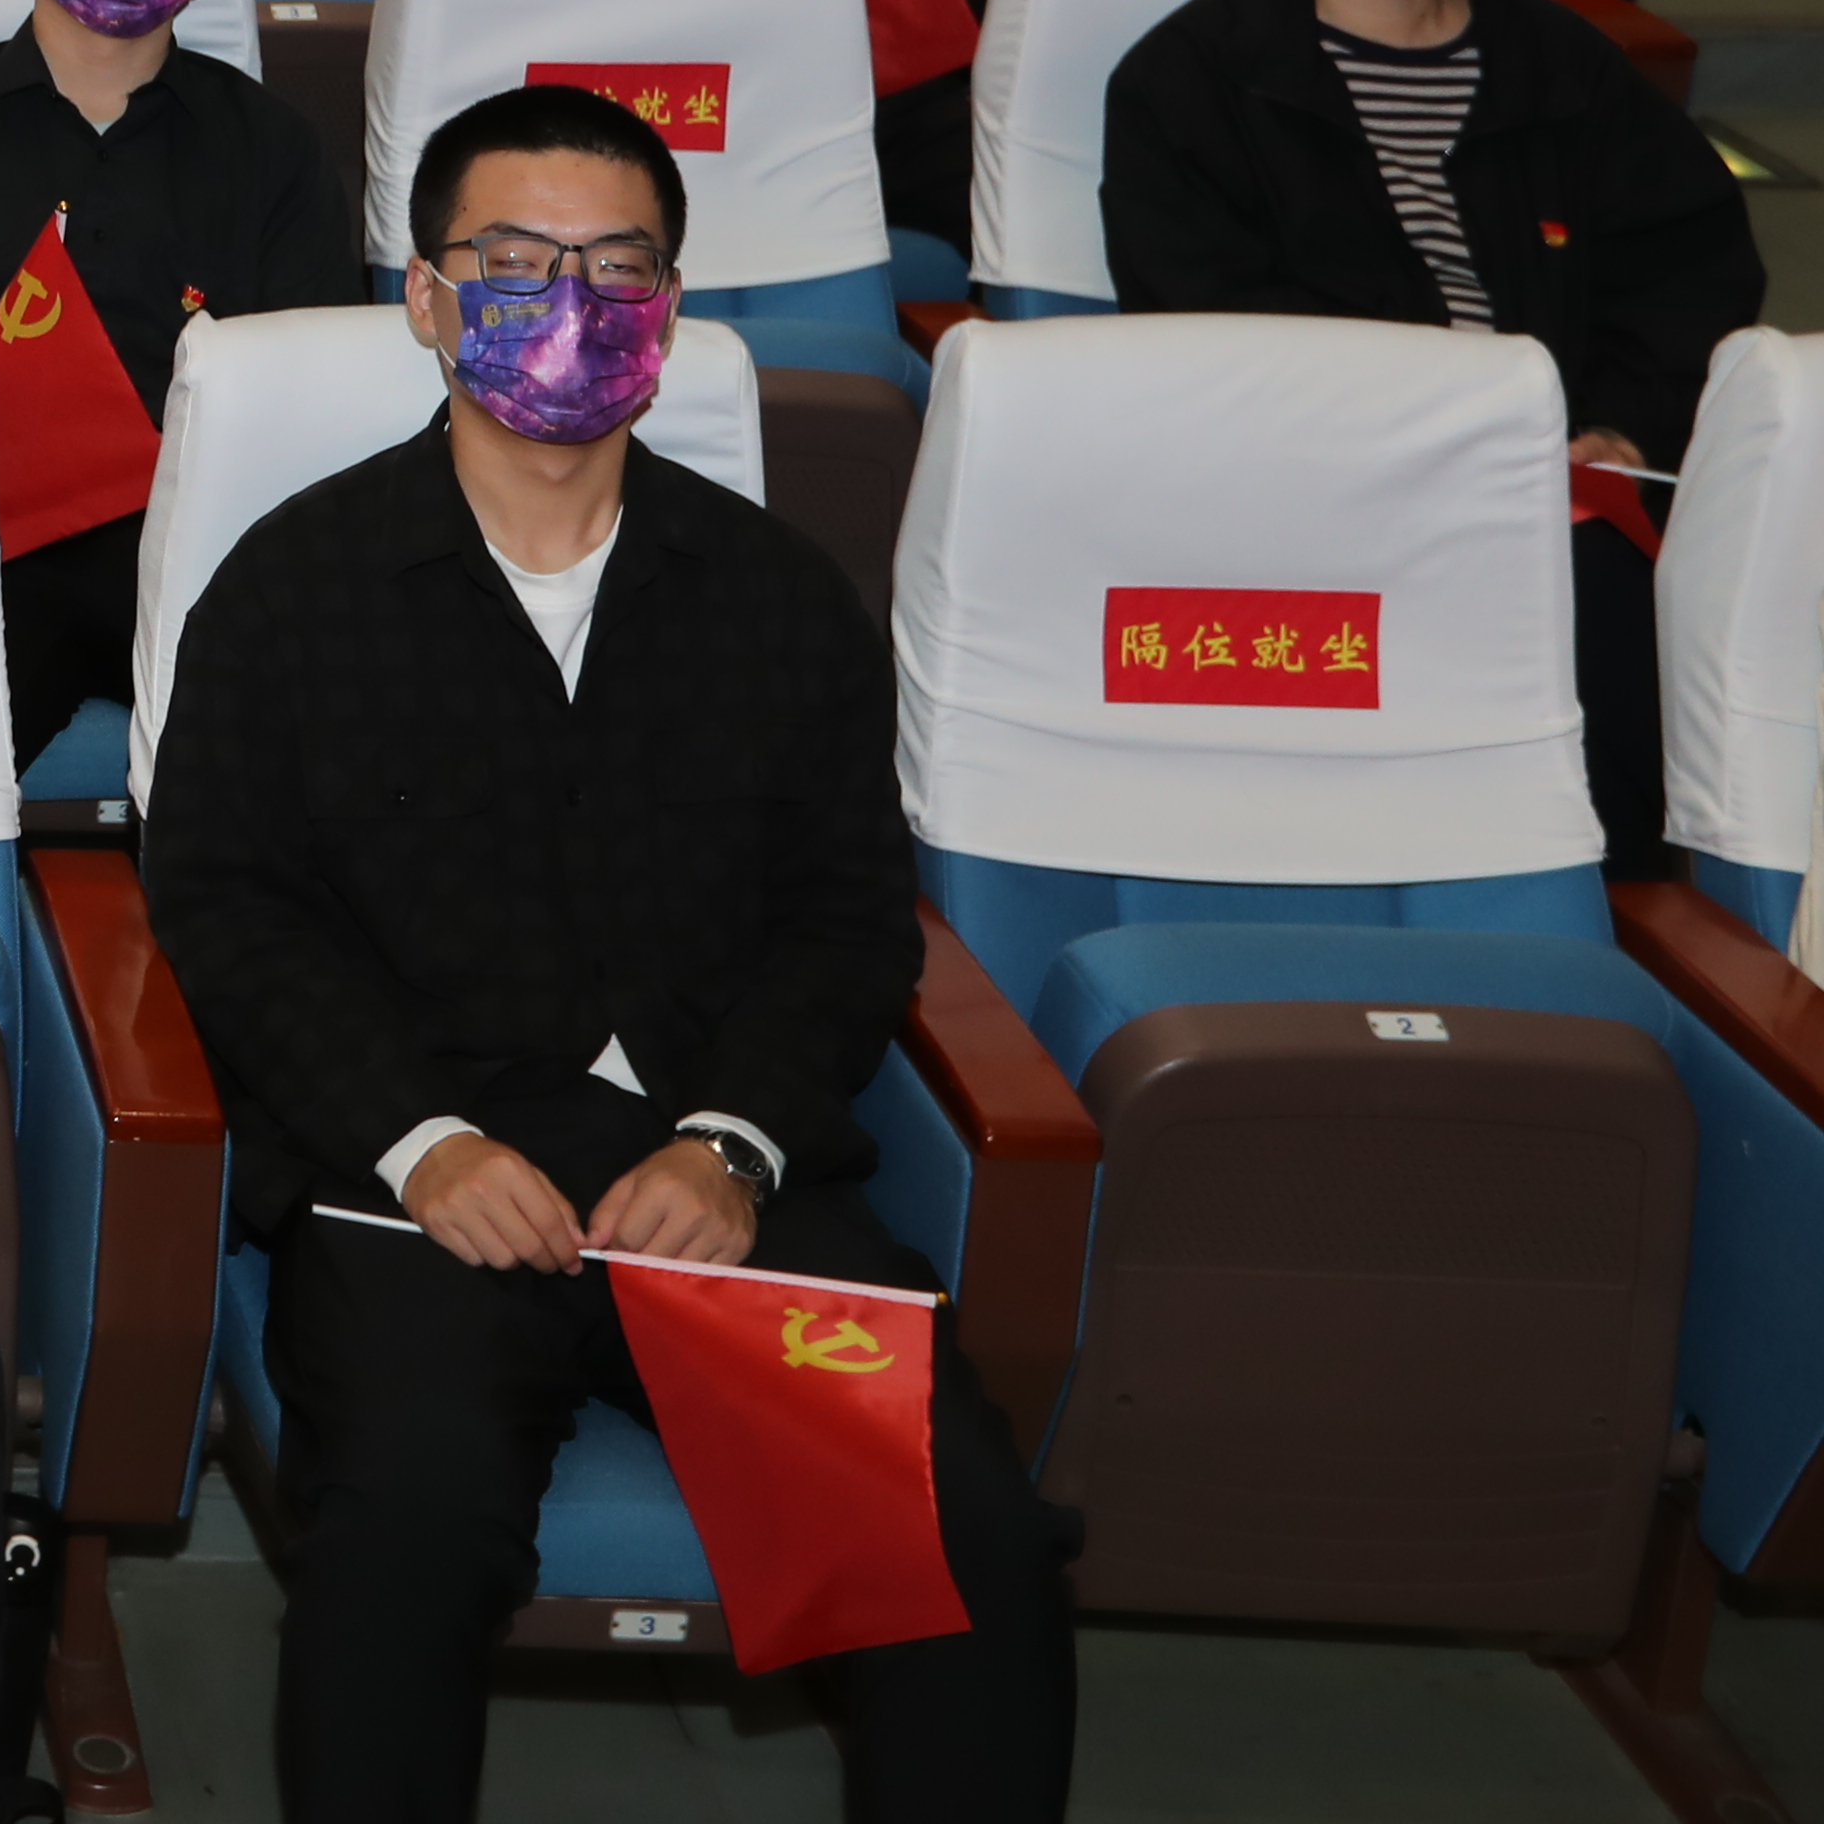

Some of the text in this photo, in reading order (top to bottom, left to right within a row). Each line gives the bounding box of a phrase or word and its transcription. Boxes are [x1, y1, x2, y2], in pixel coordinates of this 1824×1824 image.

[596, 83, 722, 126] 就坐
[1120, 621, 1371, 674] 隔位就坐
[1396, 1017, 1415, 1035] 2
[638, 1616, 655, 1635] 3
